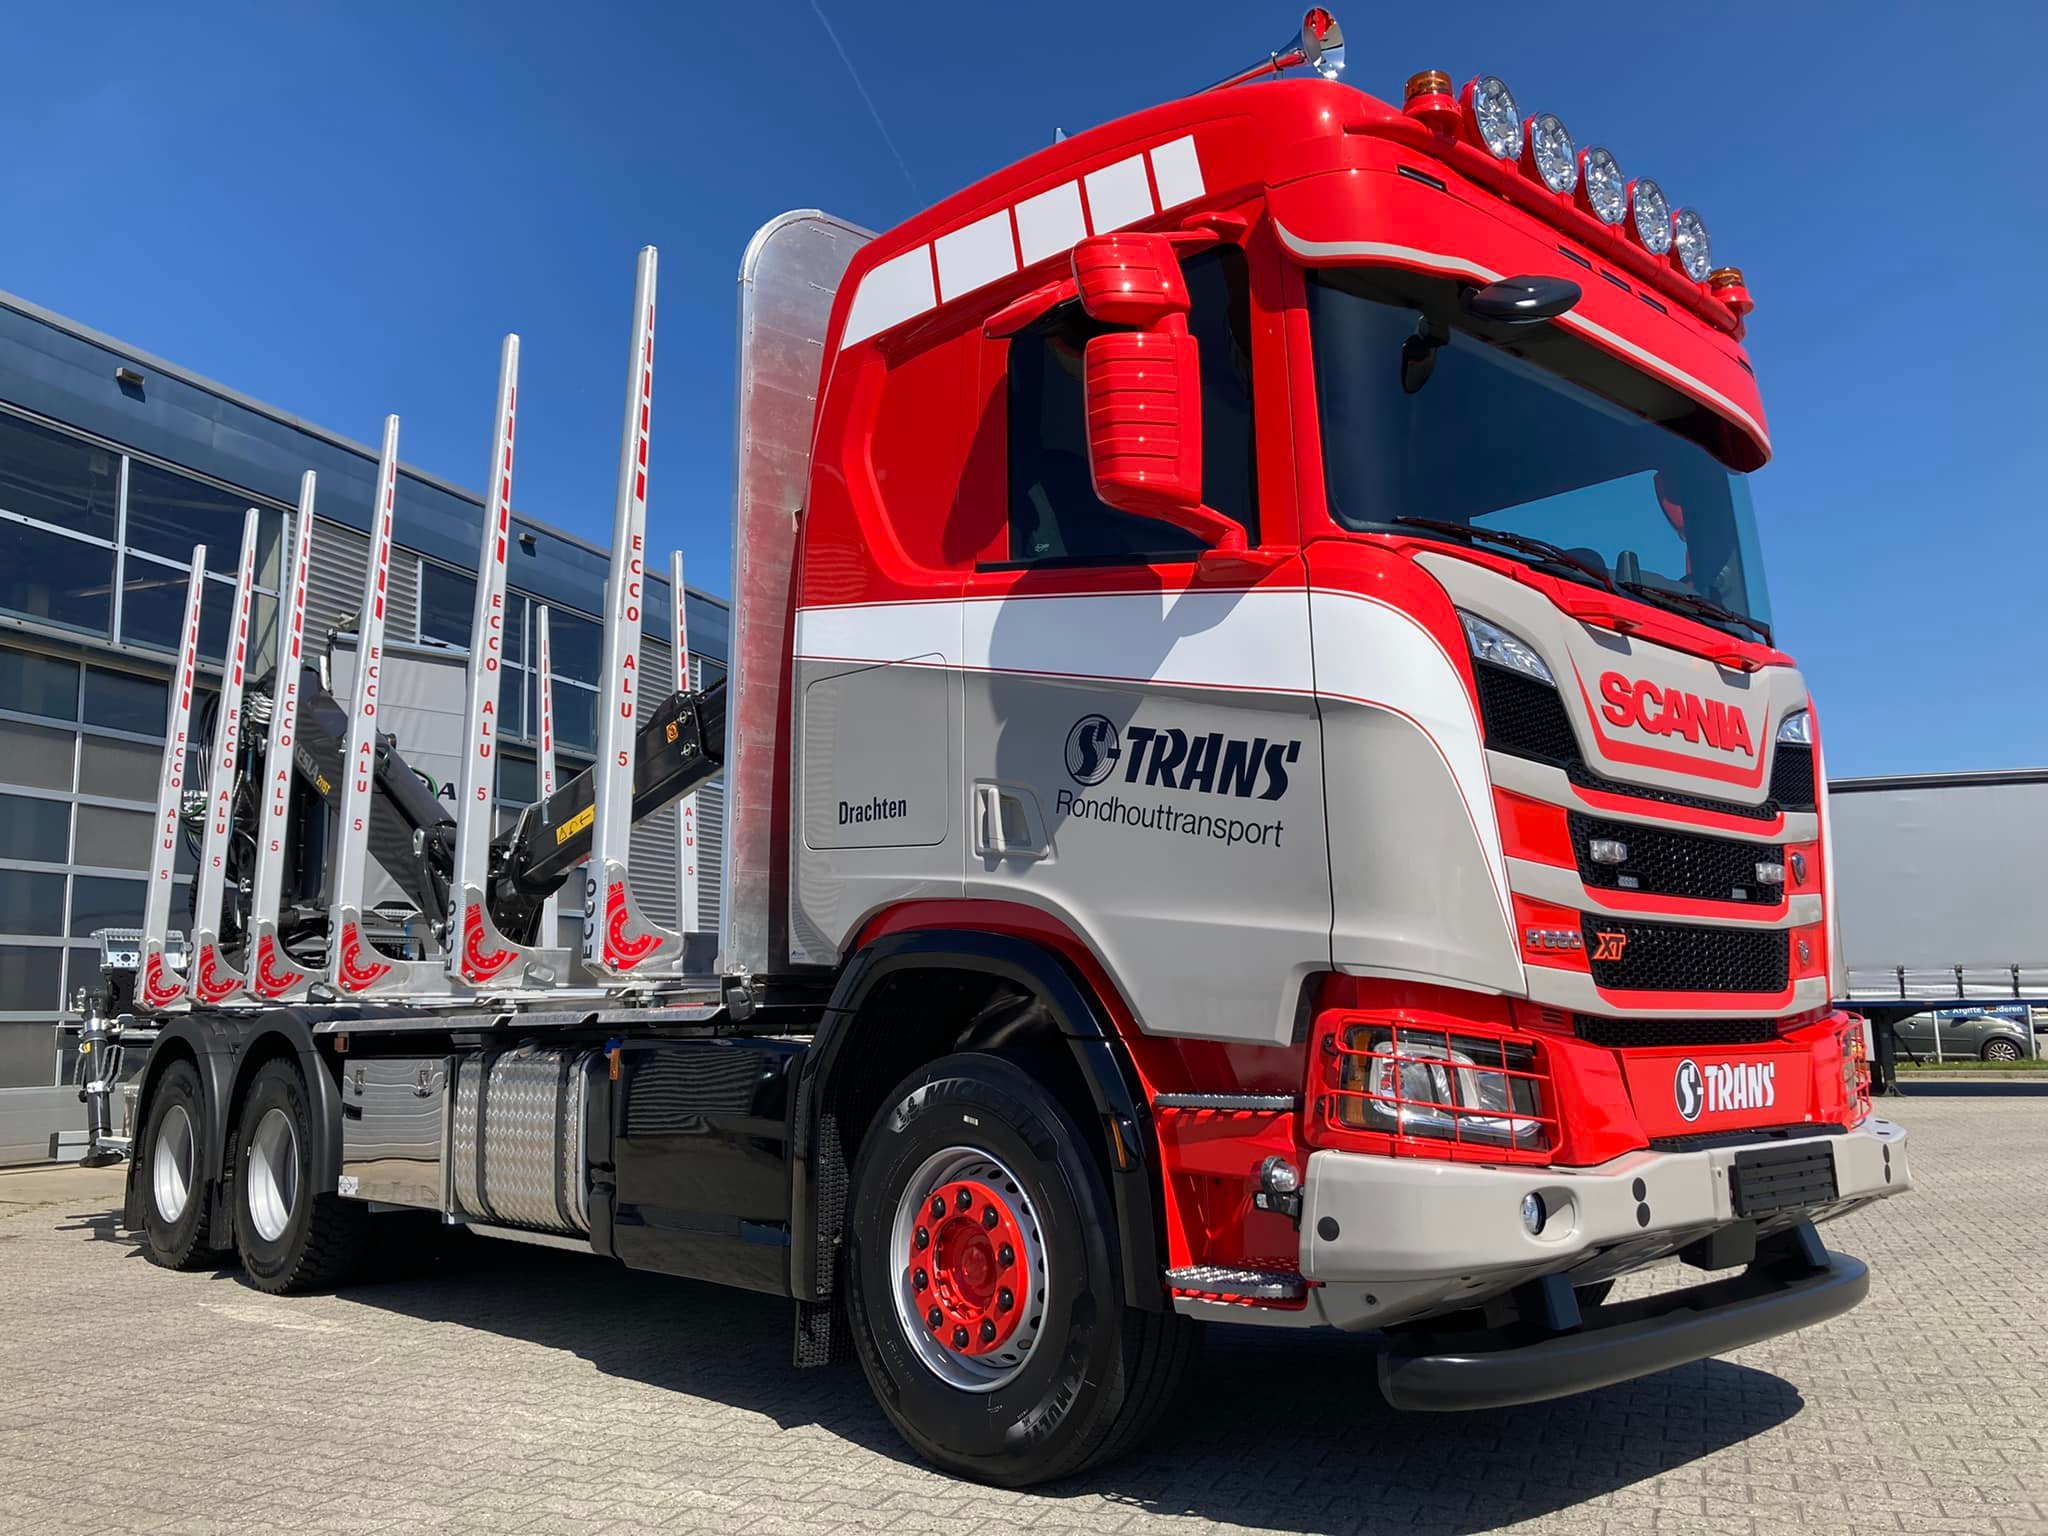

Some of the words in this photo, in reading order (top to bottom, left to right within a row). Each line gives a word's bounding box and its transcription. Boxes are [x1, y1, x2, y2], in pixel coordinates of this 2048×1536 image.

[625, 534, 644, 623] ECCO
[484, 593, 502, 673] ECCO
[363, 647, 380, 717] ECCO
[620, 653, 637, 720] ALU
[279, 683, 296, 748] ECCO
[479, 699, 495, 759] ALU
[1600, 671, 1754, 757] SCANIA
[170, 731, 186, 789] ECCO
[223, 708, 239, 769] ECCO
[617, 751, 629, 768] 5
[356, 741, 372, 794] ALU
[215, 790, 230, 835] ALU
[273, 770, 288, 817] ALU
[476, 786, 488, 801] 5
[839, 796, 907, 825] Drachten
[162, 808, 177, 850] ALU
[354, 818, 365, 832] 5
[684, 807, 694, 848] ALU
[1056, 789, 1284, 847] Rondhouttransport
[212, 856, 221, 869] 5
[270, 839, 280, 853] 5
[160, 869, 169, 881] 5
[687, 866, 695, 876] 5
[583, 879, 597, 959] ECCO
[1593, 932, 1627, 961] XT
[1983, 1005, 2023, 1015] gderen
